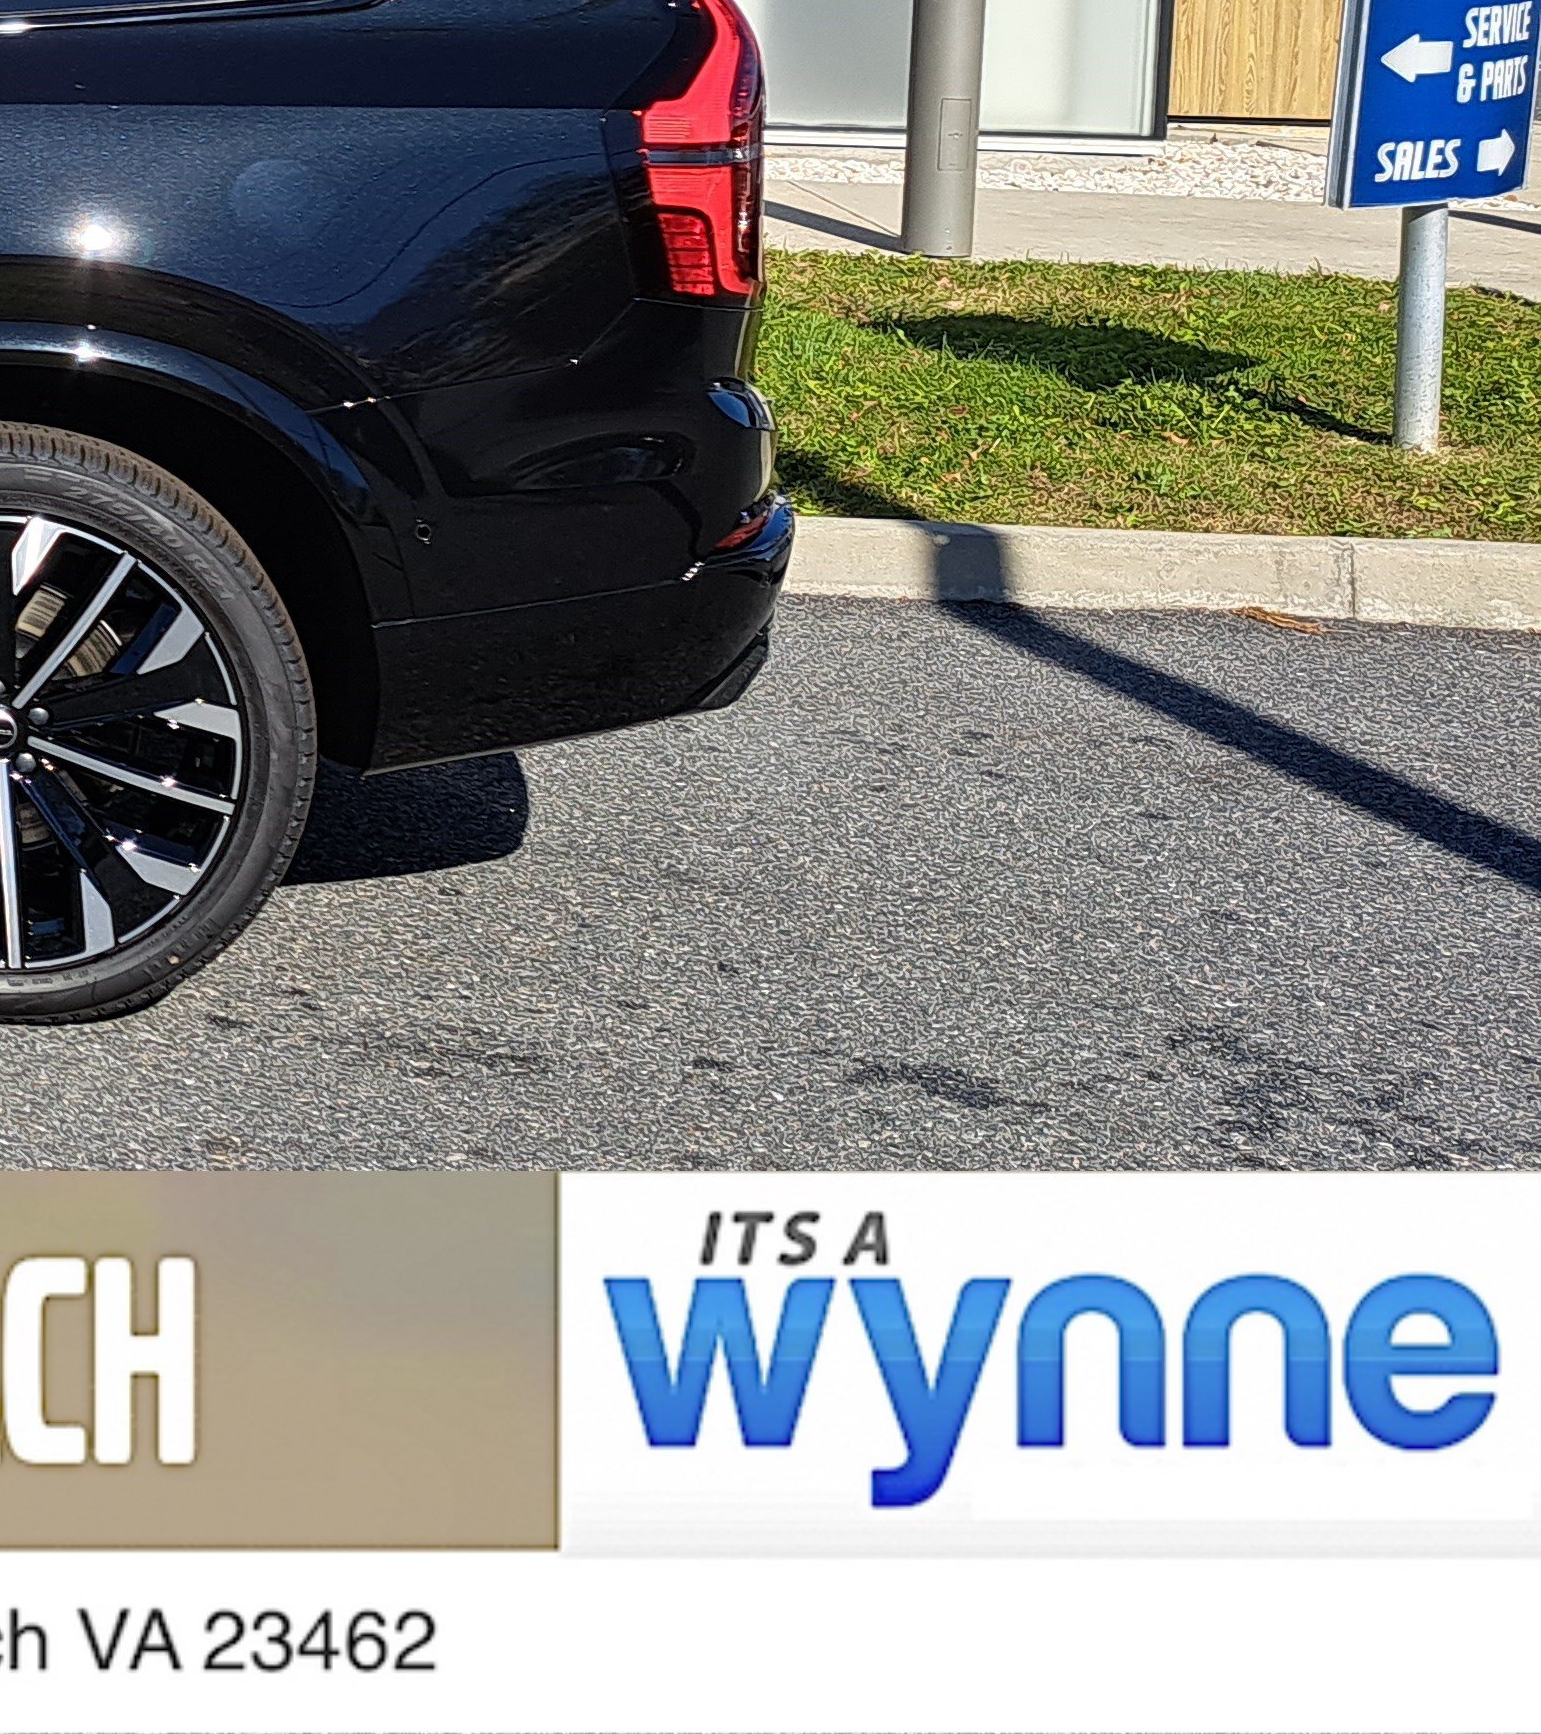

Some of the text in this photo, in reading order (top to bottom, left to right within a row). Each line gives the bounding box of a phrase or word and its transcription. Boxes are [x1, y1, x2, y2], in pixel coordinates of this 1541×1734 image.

[1462, 1, 1533, 48] SERVICE
[1456, 55, 1529, 103] & PARTS
[1374, 139, 1462, 183] SALES
